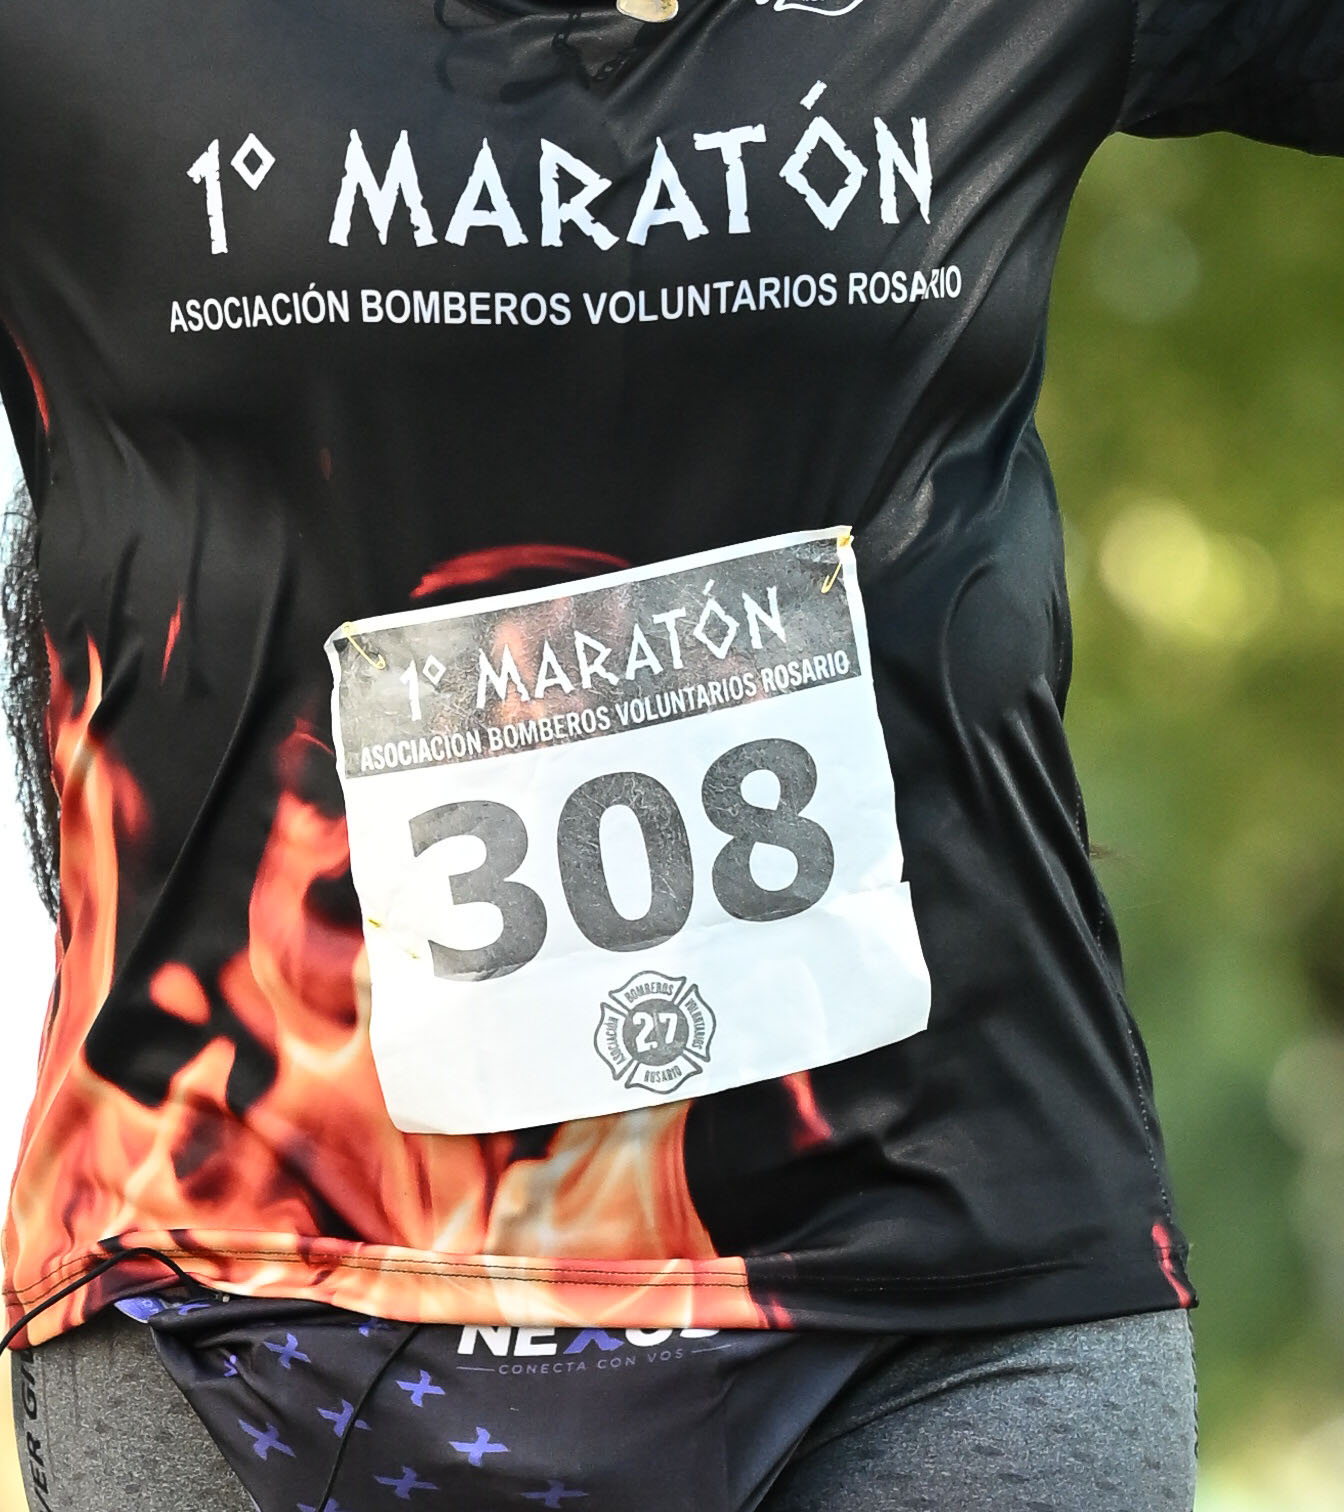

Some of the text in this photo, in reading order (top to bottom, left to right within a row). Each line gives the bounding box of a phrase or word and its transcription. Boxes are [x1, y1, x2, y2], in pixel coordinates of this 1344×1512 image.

[328, 79, 933, 252] MARATÓN
[170, 264, 962, 333] ASOCIACIÓN BOMBEROS VOLUNTARIOS ROSARIO
[476, 579, 786, 709] MARATÓN
[487, 706, 611, 752] BOMBEROS
[615, 672, 757, 726] VOLUNTARIOS
[761, 649, 850, 693] ROSARIO
[407, 738, 835, 982] 308
[624, 981, 674, 1003] BOMBEROS
[633, 1011, 678, 1053] 27
[644, 1065, 682, 1083] ROSARIO
[457, 1324, 720, 1357] NEX
[498, 1349, 684, 1375] CONECTA CON VOS
